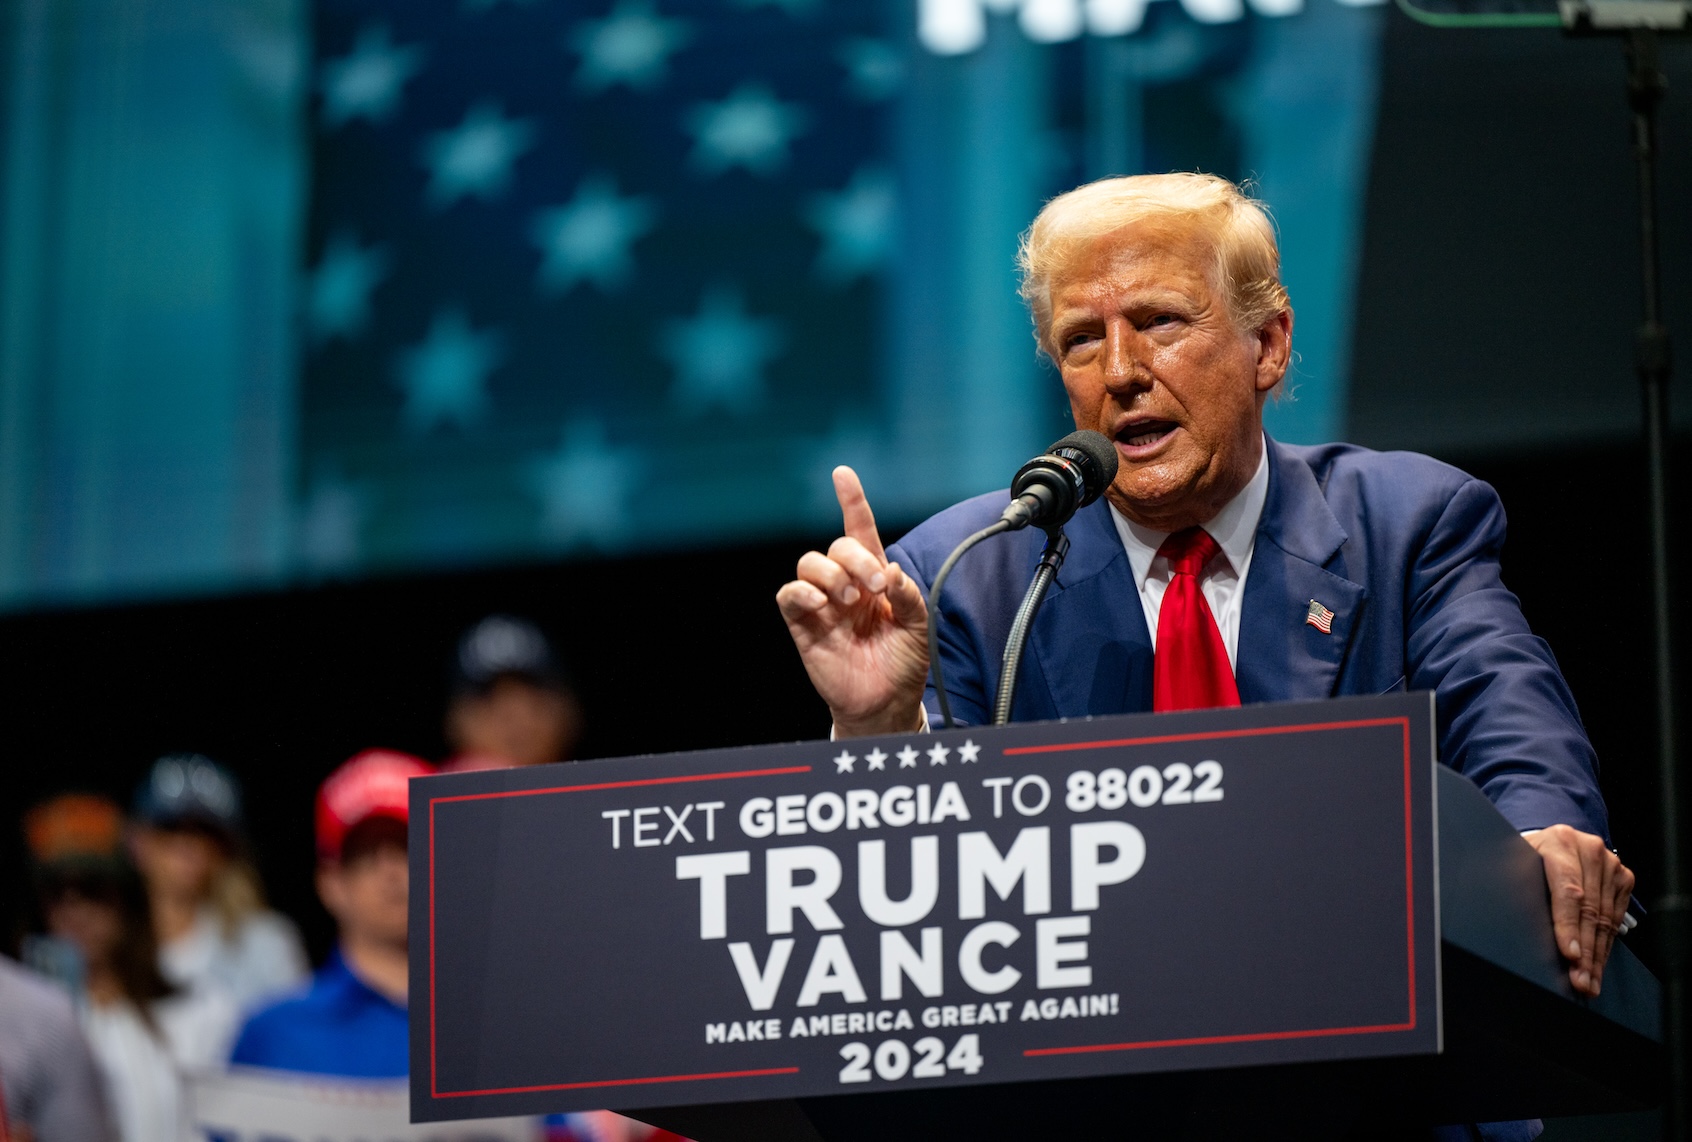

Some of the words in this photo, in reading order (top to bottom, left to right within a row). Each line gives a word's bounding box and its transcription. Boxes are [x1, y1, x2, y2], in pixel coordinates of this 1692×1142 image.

[601, 803, 726, 848] TEXT
[738, 785, 971, 839] GEORGIA
[982, 774, 1051, 819] TO
[1065, 760, 1224, 813] 88022
[675, 820, 1147, 940] TRUMP
[727, 915, 1092, 1011] VANCE
[705, 1018, 782, 1044] MAKE
[789, 1009, 914, 1038] AMERICA
[921, 1001, 1013, 1028] GREAT
[1020, 993, 1119, 1021] AGAIN!
[839, 1033, 984, 1084] 2024
